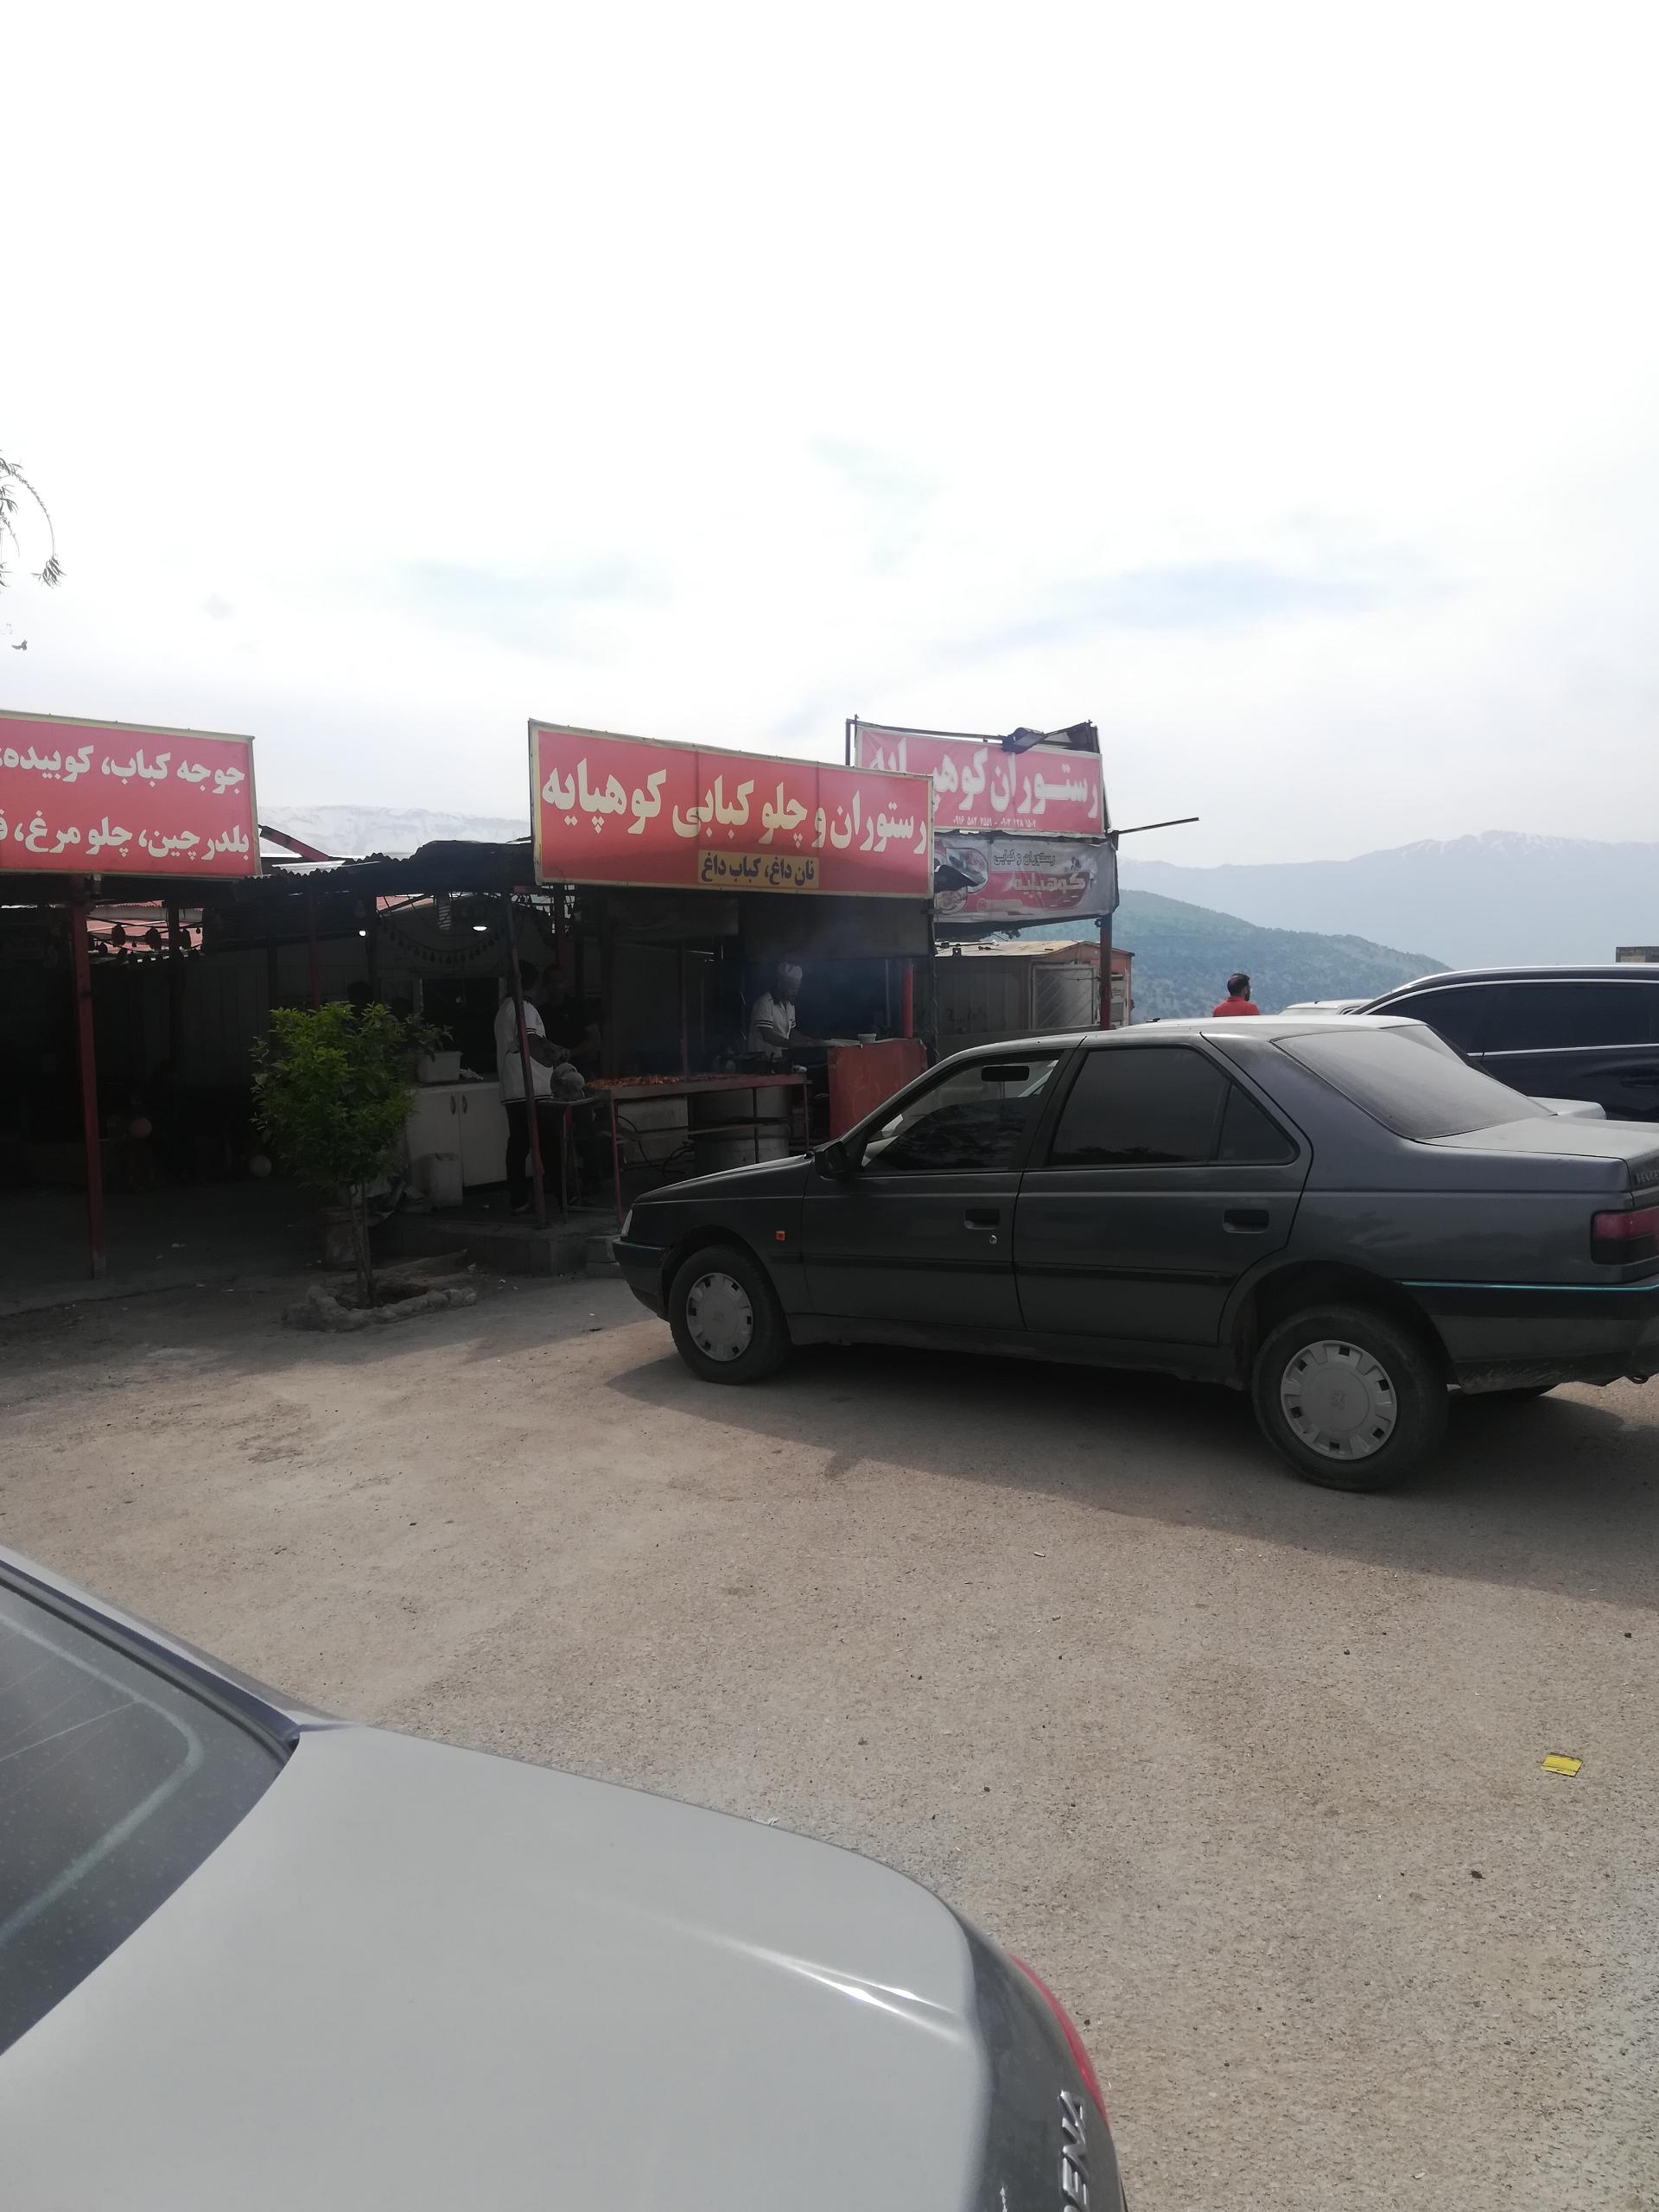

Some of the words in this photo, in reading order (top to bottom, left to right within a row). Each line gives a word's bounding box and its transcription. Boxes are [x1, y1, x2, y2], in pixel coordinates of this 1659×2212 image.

[101, 749, 171, 787] کباب،
[176, 760, 245, 794] جوجه
[990, 753, 1099, 818] رستوران
[542, 758, 667, 835] کوهپایه
[672, 775, 754, 838] کبابی
[759, 782, 808, 849] چلو
[14, 809, 81, 854] مرغ،
[86, 816, 133, 858] چلو
[811, 806, 826, 848] و
[830, 790, 927, 855] رستوران
[701, 852, 727, 882] داغ
[729, 856, 761, 884] کباب
[765, 855, 792, 885] داغ،
[794, 859, 815, 885] نان
